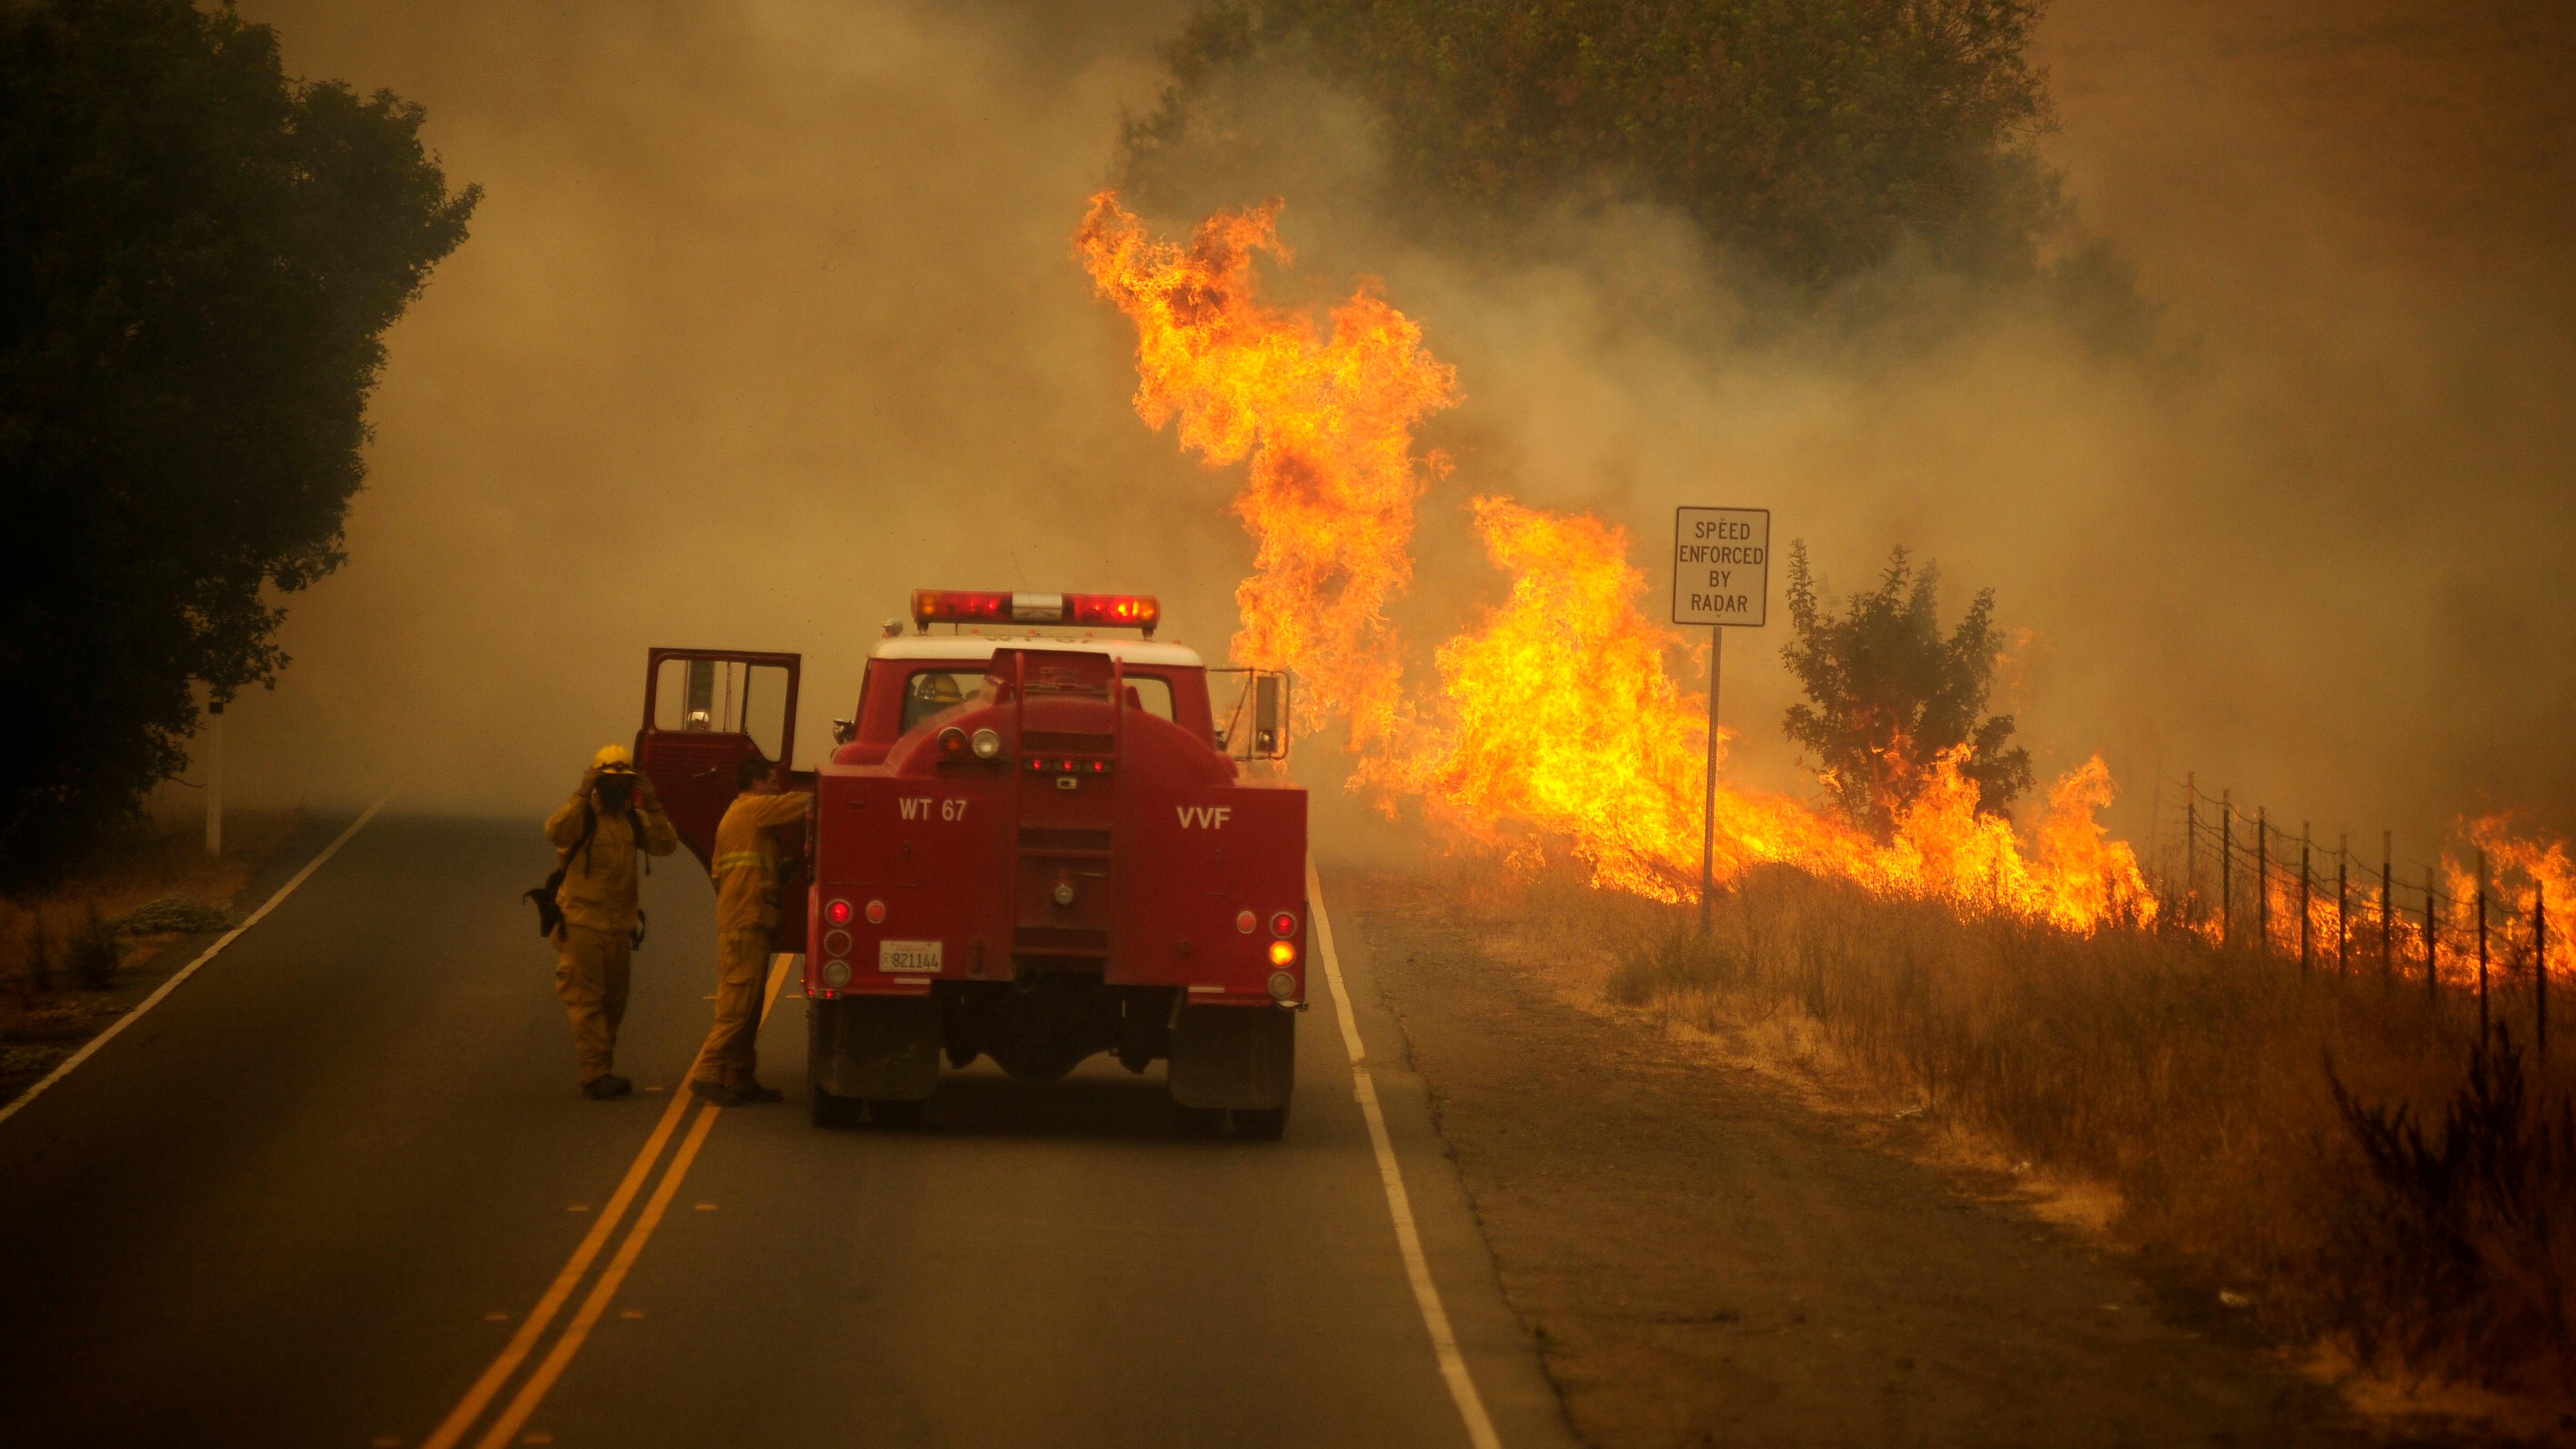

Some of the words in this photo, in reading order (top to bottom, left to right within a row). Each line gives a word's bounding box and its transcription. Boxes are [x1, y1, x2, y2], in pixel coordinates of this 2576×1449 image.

[1695, 521, 1750, 540] SPEED
[1679, 545, 1764, 564] ENFORCED
[1709, 570, 1731, 588] BY
[1691, 594, 1748, 612] RADAR
[899, 798, 932, 820] WT
[942, 799, 967, 821] 67
[1177, 807, 1231, 830] VVF
